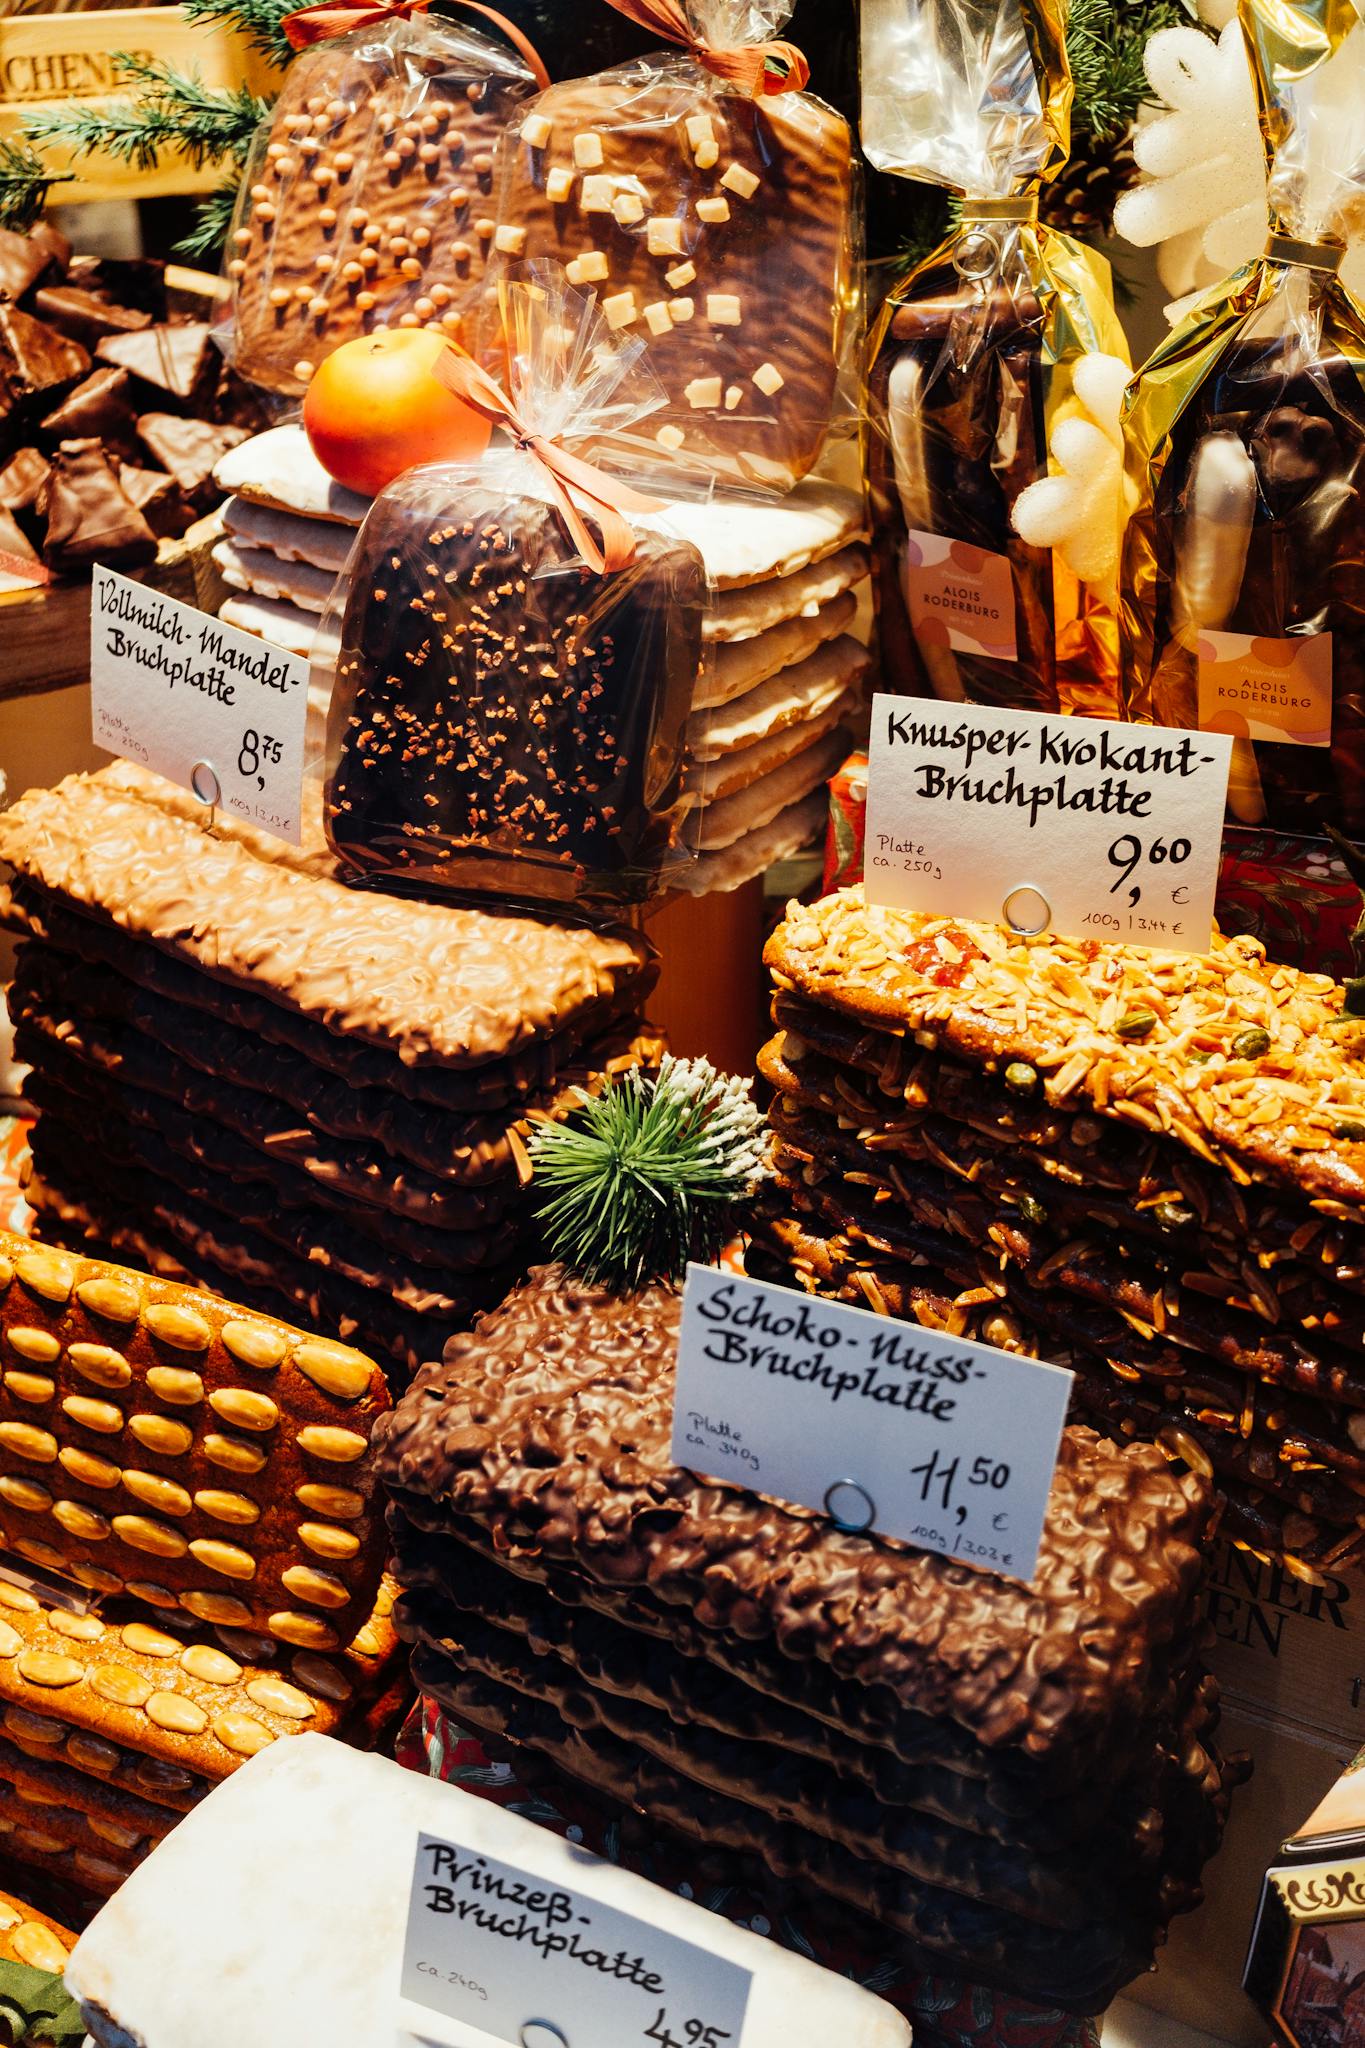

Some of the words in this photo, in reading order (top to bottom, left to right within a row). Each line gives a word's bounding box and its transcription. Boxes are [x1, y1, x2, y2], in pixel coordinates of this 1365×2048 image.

[943, 586, 981, 602] ALOIS
[923, 594, 1000, 620] RODERBURG
[106, 627, 236, 706] Bruchplatte
[1218, 687, 1312, 708] RODERBURG
[1241, 680, 1288, 694] ALOIS
[914, 764, 1153, 828] Bruchplatte
[877, 834, 926, 856] Platte
[873, 856, 896, 867] ca.
[1170, 886, 1190, 905] €
[1081, 913, 1120, 931] 100g
[703, 1327, 958, 1422] Bruchplatte
[687, 1411, 742, 1441] Platte
[991, 1512, 1009, 1531] €
[423, 1843, 592, 1928] Prinzeß-
[423, 1884, 666, 1994] Bruchplatte
